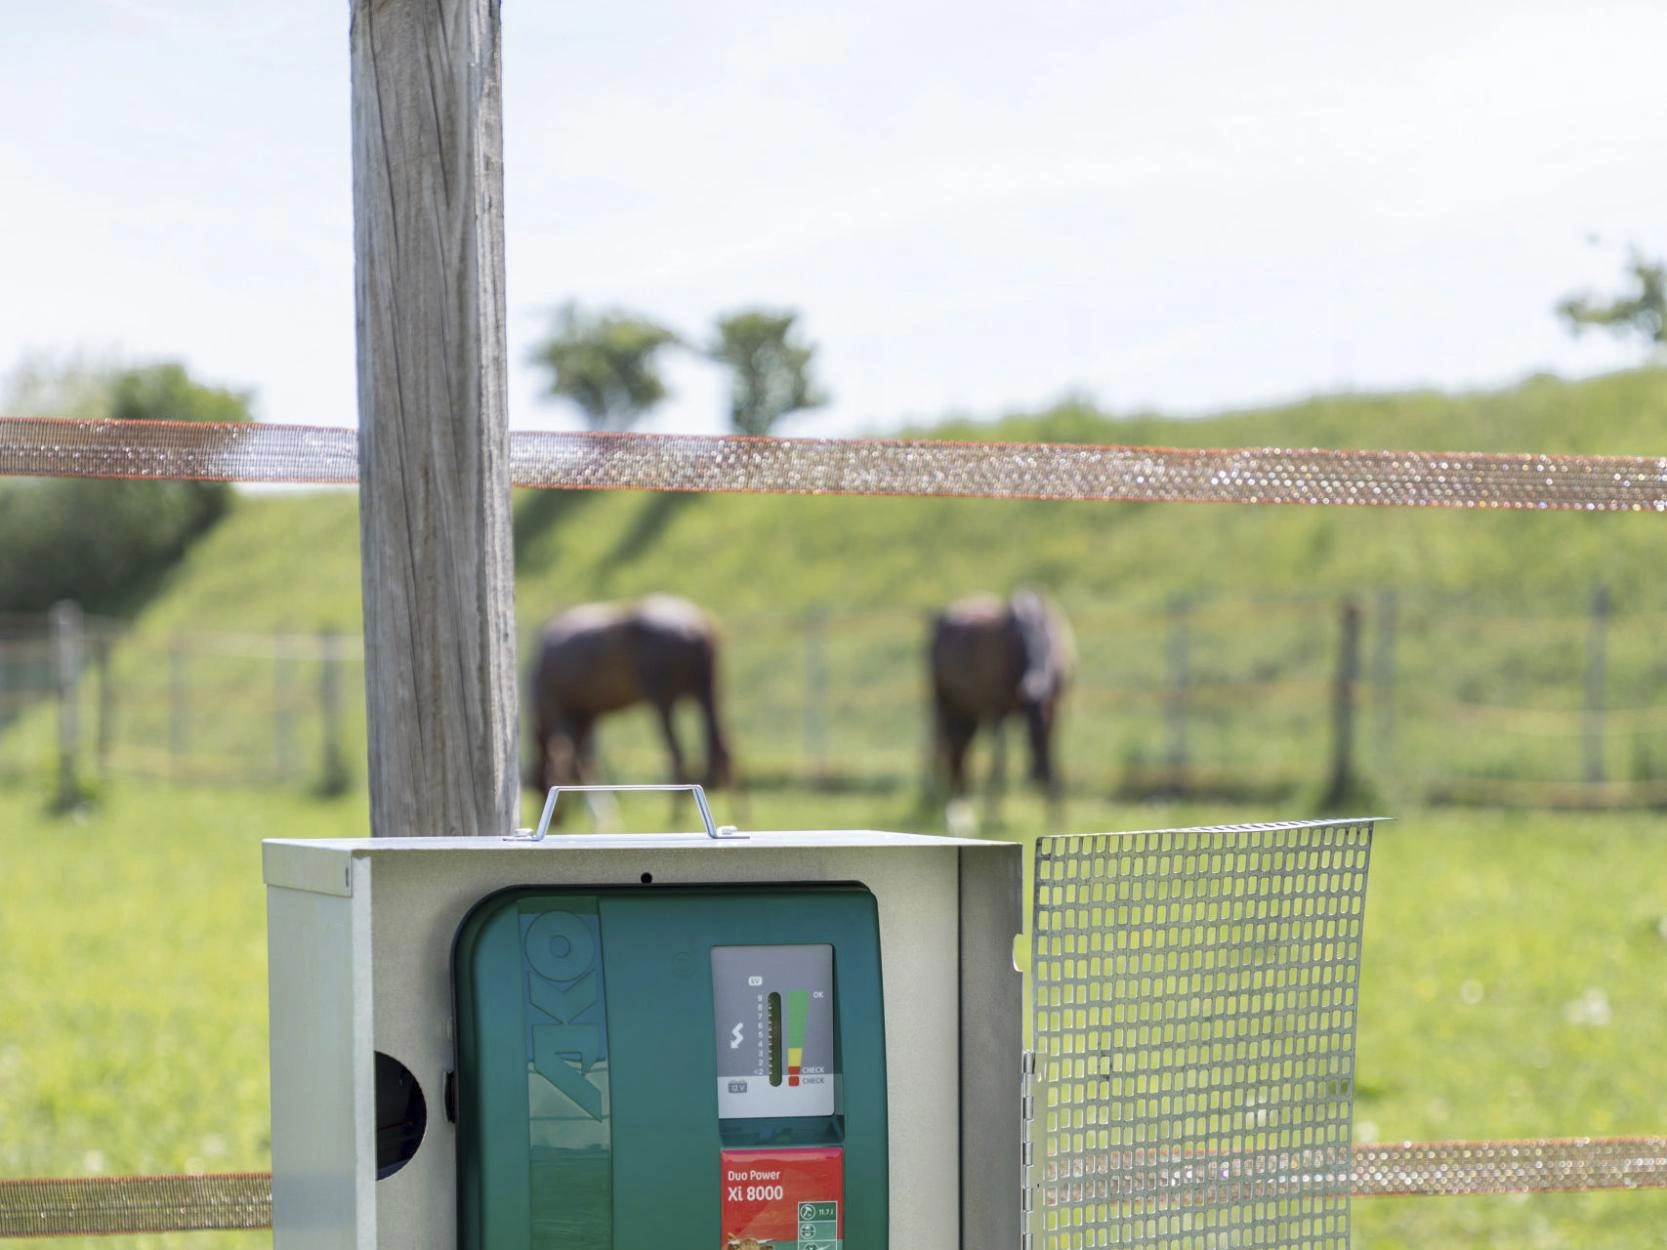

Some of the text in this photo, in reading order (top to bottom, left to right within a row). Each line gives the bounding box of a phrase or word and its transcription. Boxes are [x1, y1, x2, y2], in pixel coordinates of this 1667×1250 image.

[524, 910, 602, 1123] AKO
[801, 1066, 825, 1074] CHECK
[727, 1169, 781, 1181] Duo Power
[727, 1185, 784, 1201] Xi 8000
